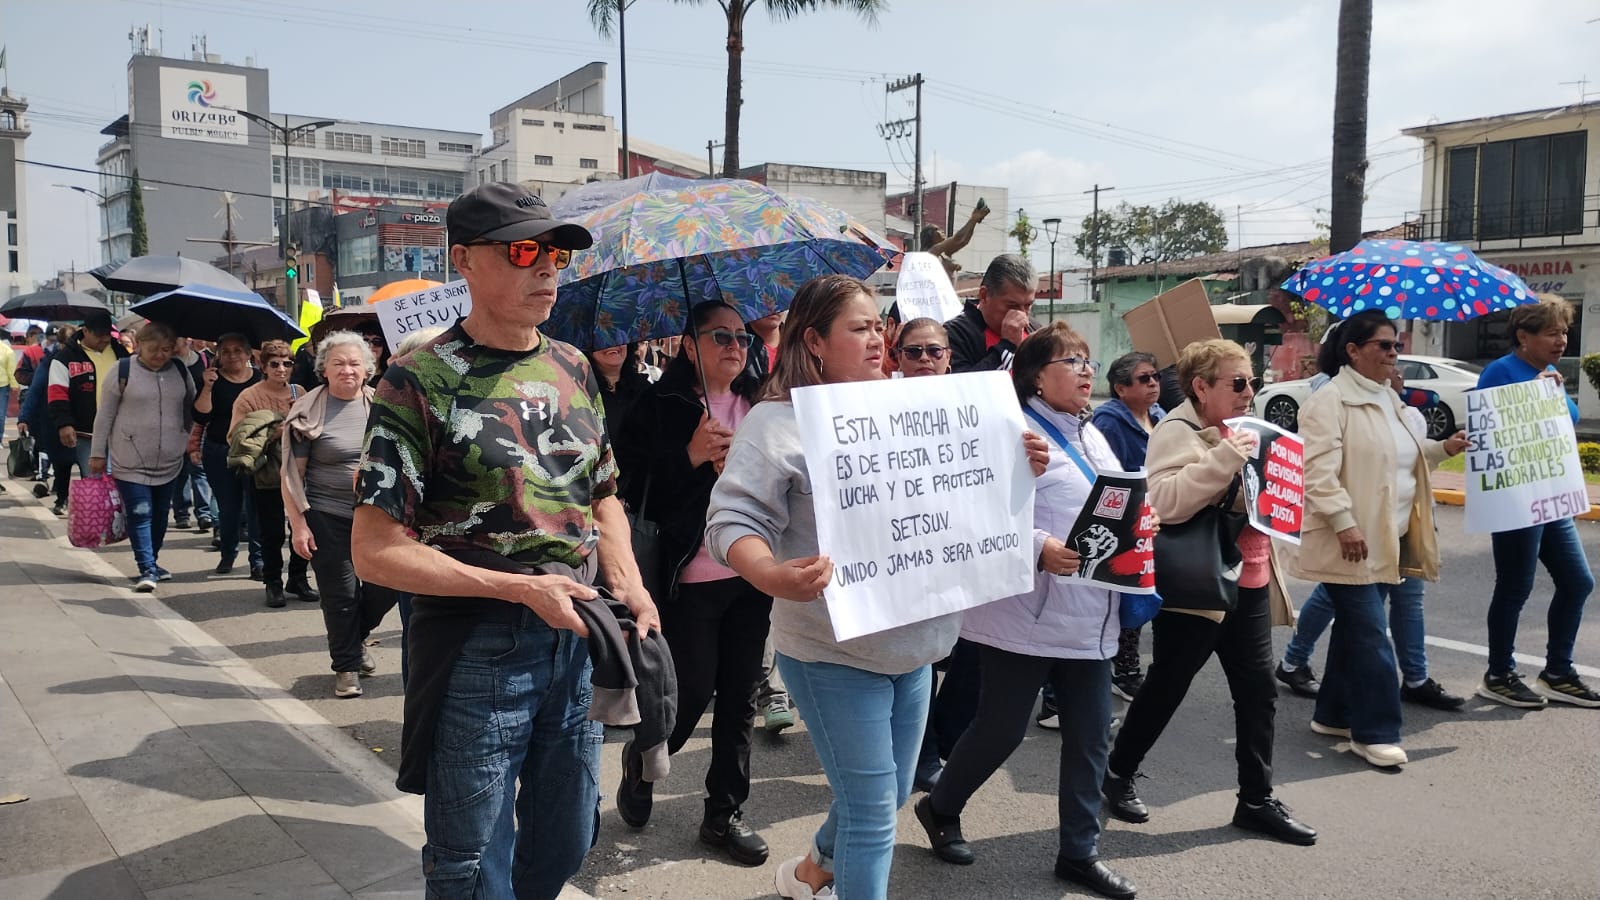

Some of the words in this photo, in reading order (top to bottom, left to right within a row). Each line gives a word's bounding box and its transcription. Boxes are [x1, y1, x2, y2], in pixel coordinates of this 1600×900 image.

[1500, 261, 1573, 277] ONARIA
[394, 298, 408, 312] SE
[411, 293, 427, 306] VE
[1467, 393, 1489, 412] LA
[1491, 382, 1540, 409] UNIDAD
[832, 415, 881, 445] ESTA
[889, 408, 950, 438] MARCHA
[957, 404, 979, 429] NO
[1467, 432, 1489, 453] SE
[1494, 423, 1543, 449] REFLEJA
[1545, 420, 1560, 439] EN
[1468, 411, 1496, 433] LOS
[836, 455, 852, 480] ES
[859, 455, 880, 475] DE
[888, 448, 931, 470] FIESTA
[938, 443, 954, 464] ES
[962, 438, 979, 461] DE
[1271, 441, 1287, 460] POR
[1287, 449, 1303, 468] UNA
[1470, 451, 1505, 472] LAS
[1507, 434, 1572, 466] CONQUISTAS
[839, 486, 879, 510] LUCHA
[886, 480, 896, 500] Y
[904, 478, 925, 497] DE
[933, 467, 994, 493] PROTESTA
[1267, 461, 1303, 487] REVISIÓN
[1481, 457, 1565, 491] LABORALES
[1270, 503, 1295, 525] JUSTA
[1531, 490, 1586, 524] SETSUV
[835, 560, 878, 588] UNIDO
[887, 549, 934, 576] JAMAS
[942, 542, 975, 564] SERA
[977, 532, 1019, 555] VENCIDO
